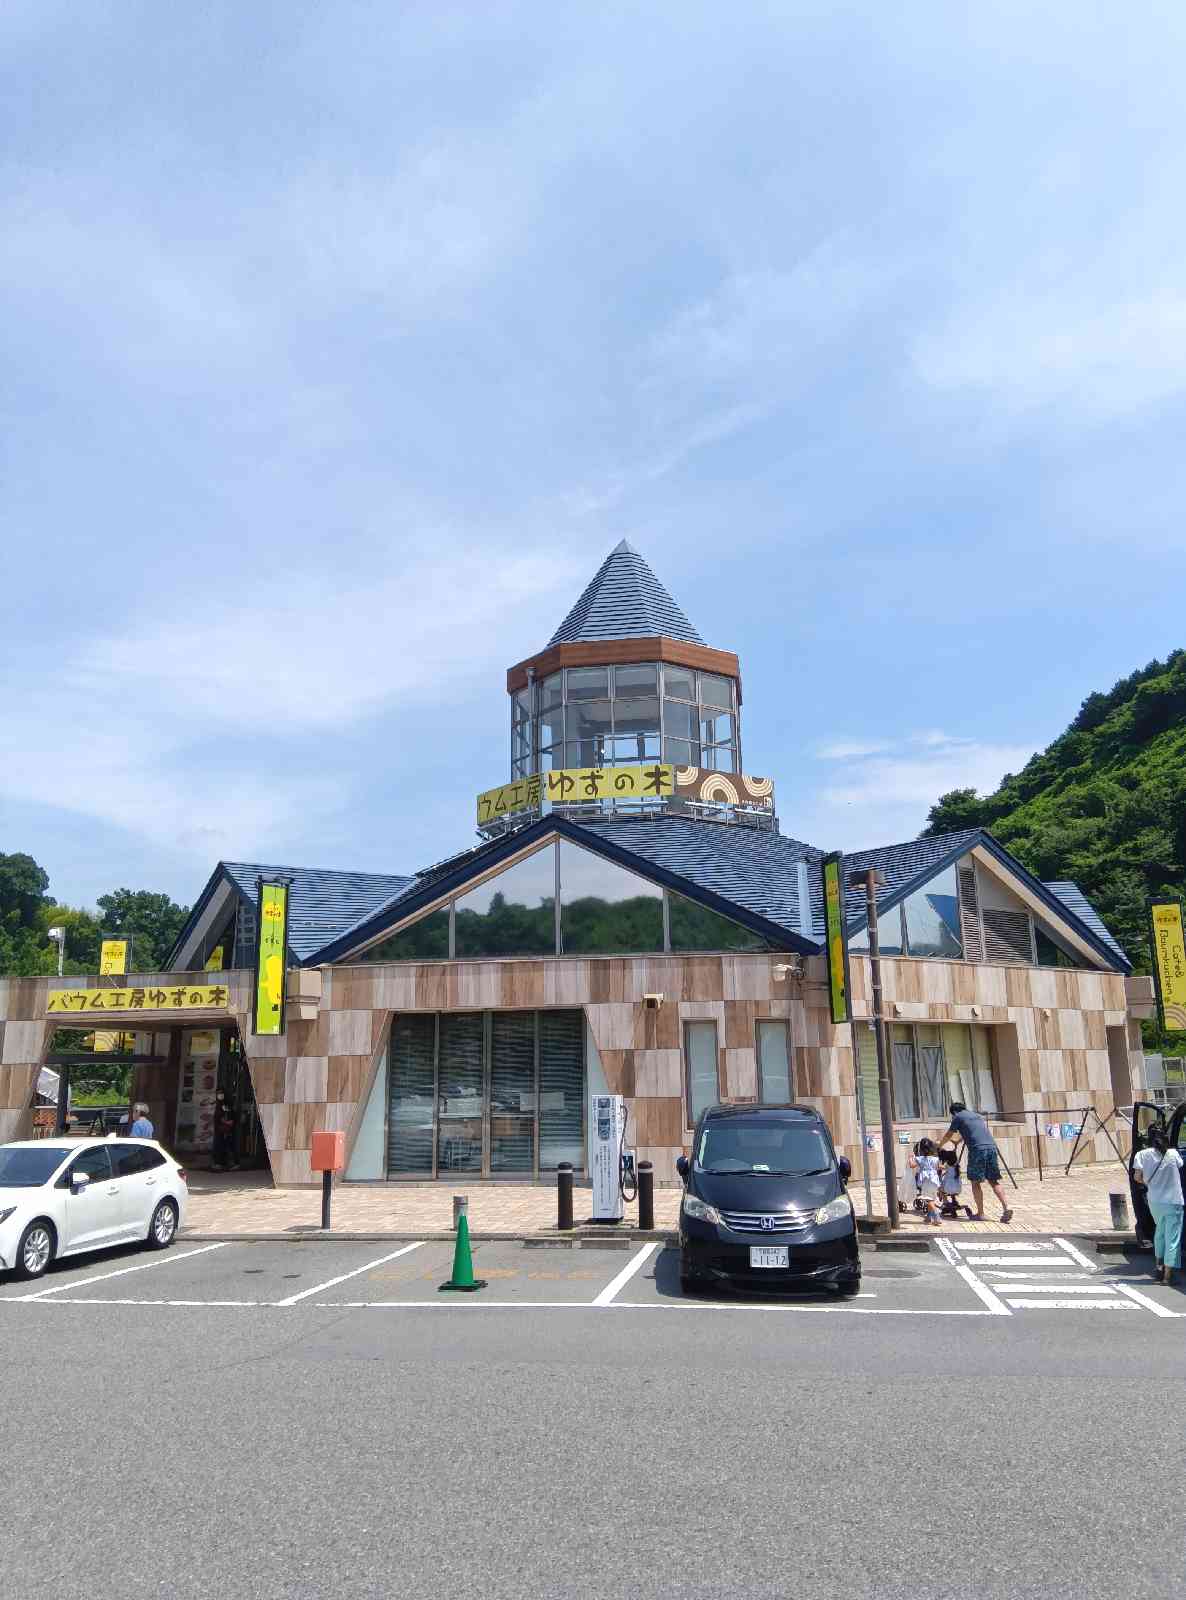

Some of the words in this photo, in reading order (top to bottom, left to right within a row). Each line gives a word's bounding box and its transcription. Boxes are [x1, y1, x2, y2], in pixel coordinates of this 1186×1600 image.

[548, 765, 671, 799] ゆずの木
[48, 986, 226, 1010] バウム工房ゆずの木
